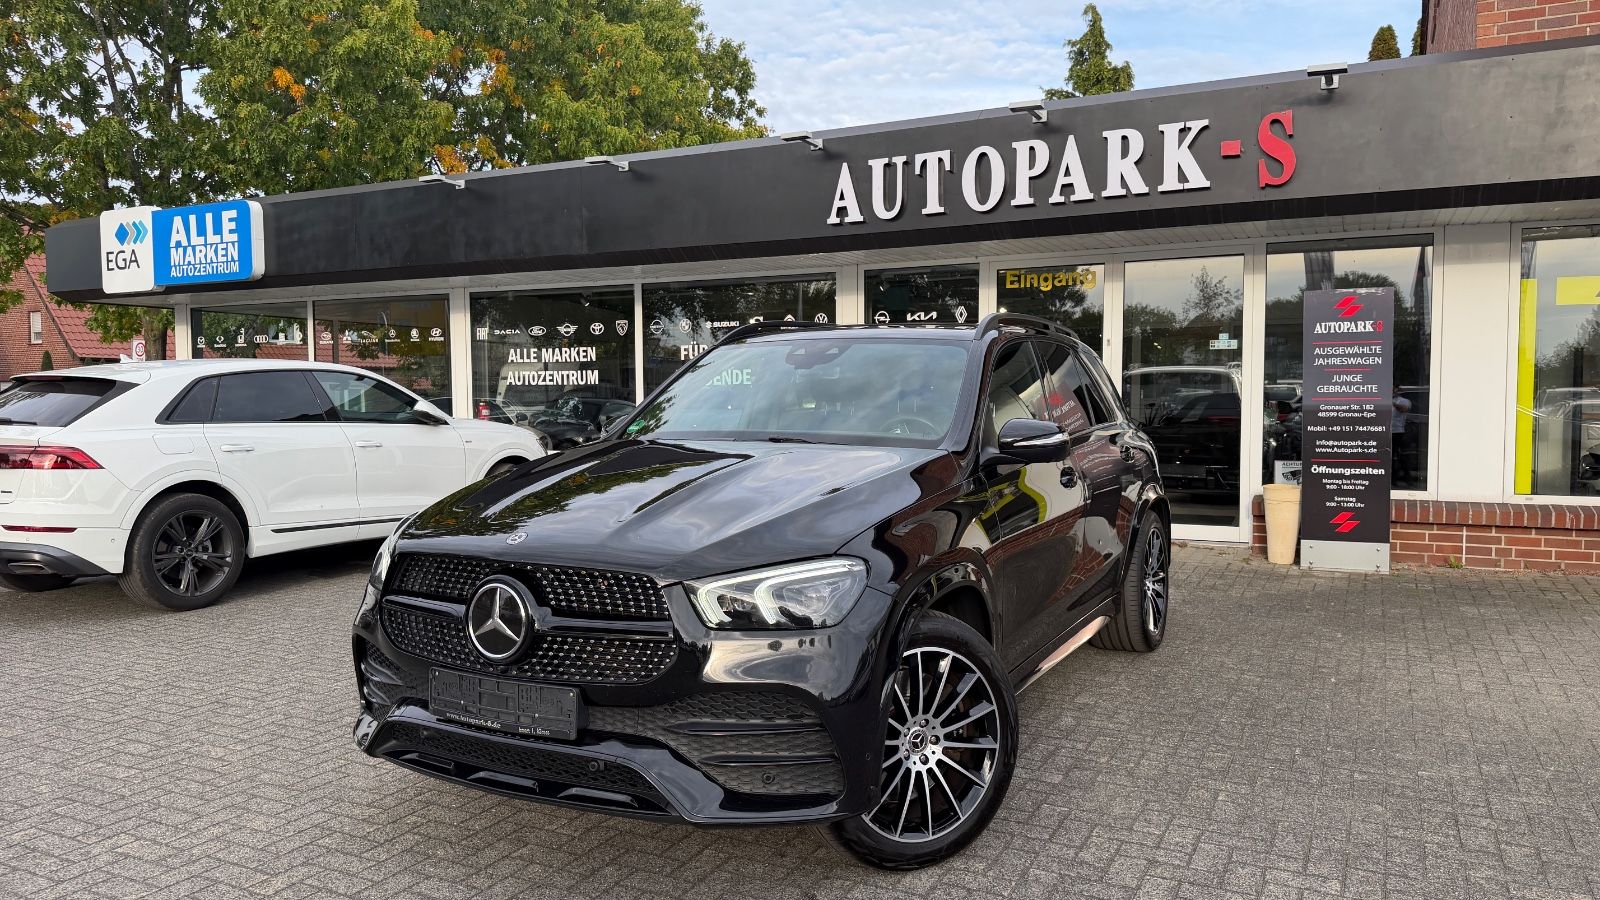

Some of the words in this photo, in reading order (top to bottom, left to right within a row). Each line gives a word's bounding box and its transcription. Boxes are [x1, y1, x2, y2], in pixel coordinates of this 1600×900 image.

[169, 209, 239, 247] ALLE
[106, 248, 140, 272] EGA
[170, 242, 239, 265] MARKEN
[170, 262, 239, 278] AUTOZENTRUM
[1005, 268, 1097, 292] Eingang
[713, 320, 740, 328] SUZUKI
[1313, 320, 1384, 334] AUTOPARK-S
[476, 327, 488, 340] FIAT
[508, 348, 538, 363] ALLE
[541, 346, 596, 362] MARKEN
[1313, 345, 1382, 355] AUSGEWÄHLTE
[1313, 357, 1382, 366] JAHRESWAGEN
[506, 369, 599, 386] AUTOZENTRUM
[1332, 374, 1362, 382] JUNGE
[1316, 385, 1378, 393] GEBRAUCHTE
[1311, 465, 1385, 476] Öffnungszeiten
